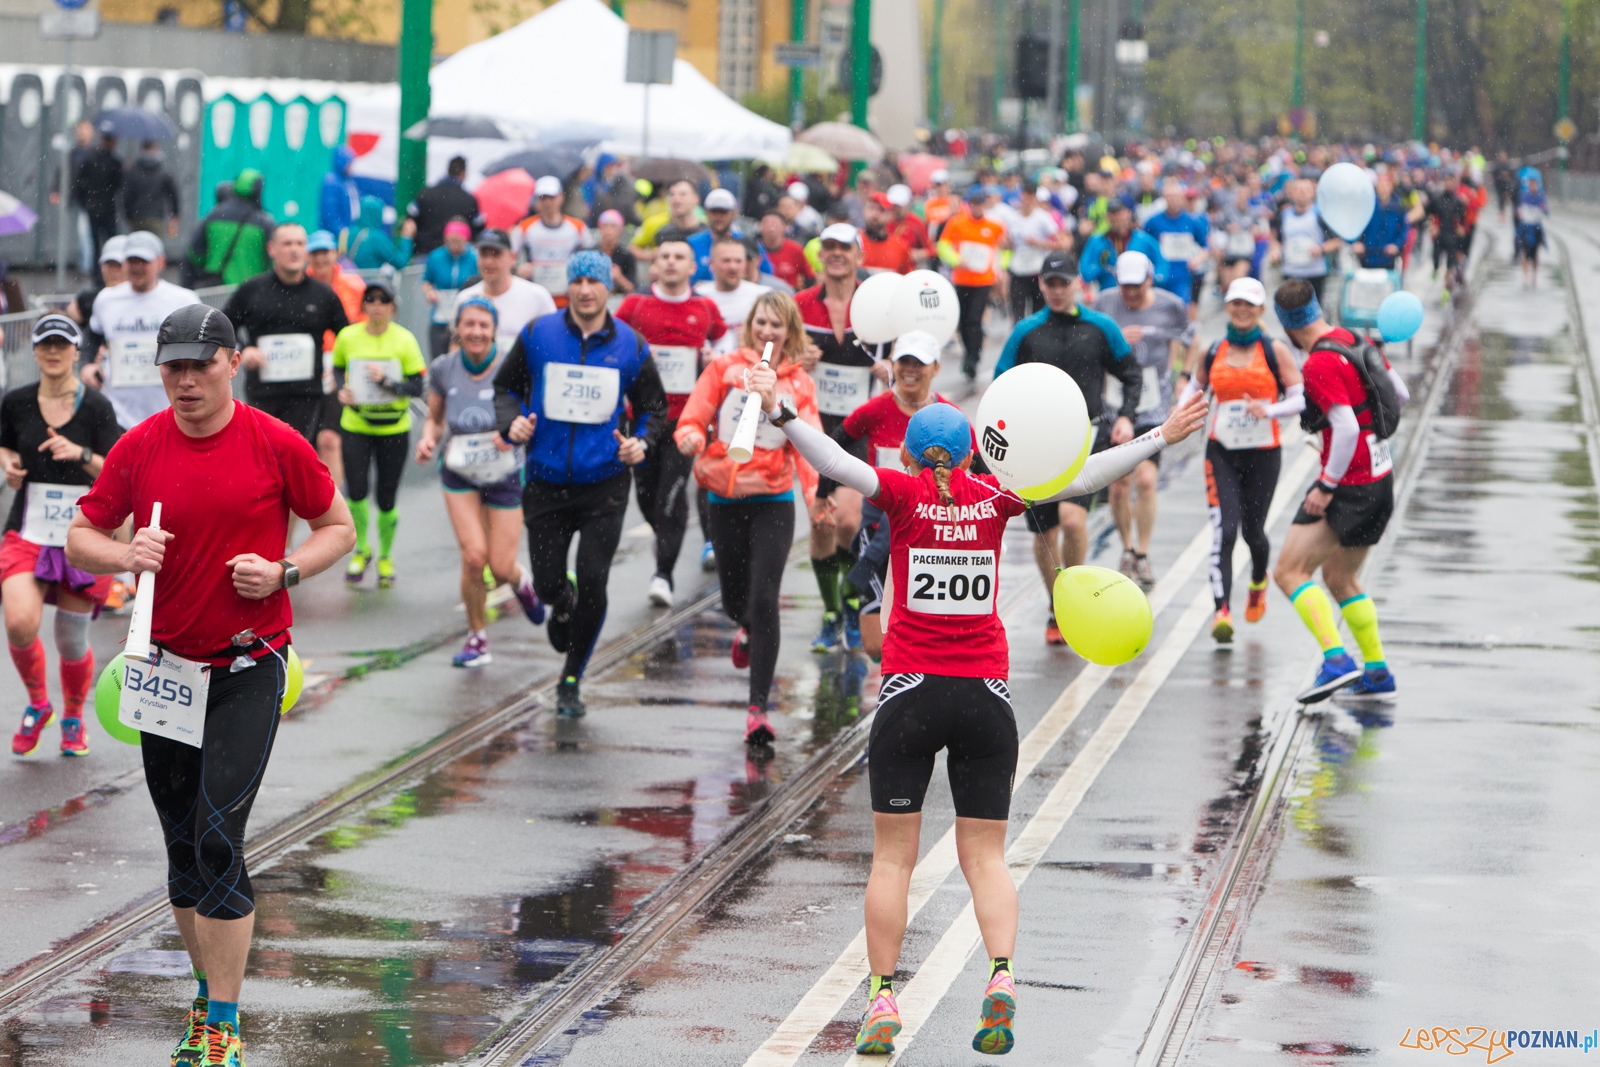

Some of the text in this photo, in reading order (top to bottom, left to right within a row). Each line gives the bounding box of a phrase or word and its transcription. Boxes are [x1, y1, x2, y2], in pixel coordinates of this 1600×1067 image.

[562, 382, 602, 401] 2316
[913, 502, 998, 522] PACEMAKER
[933, 524, 978, 542] TEAM
[912, 554, 993, 566] PACEMAKER TEAM
[912, 573, 991, 601] 2:00
[124, 665, 193, 707] 13459
[139, 697, 168, 710] Krystian
